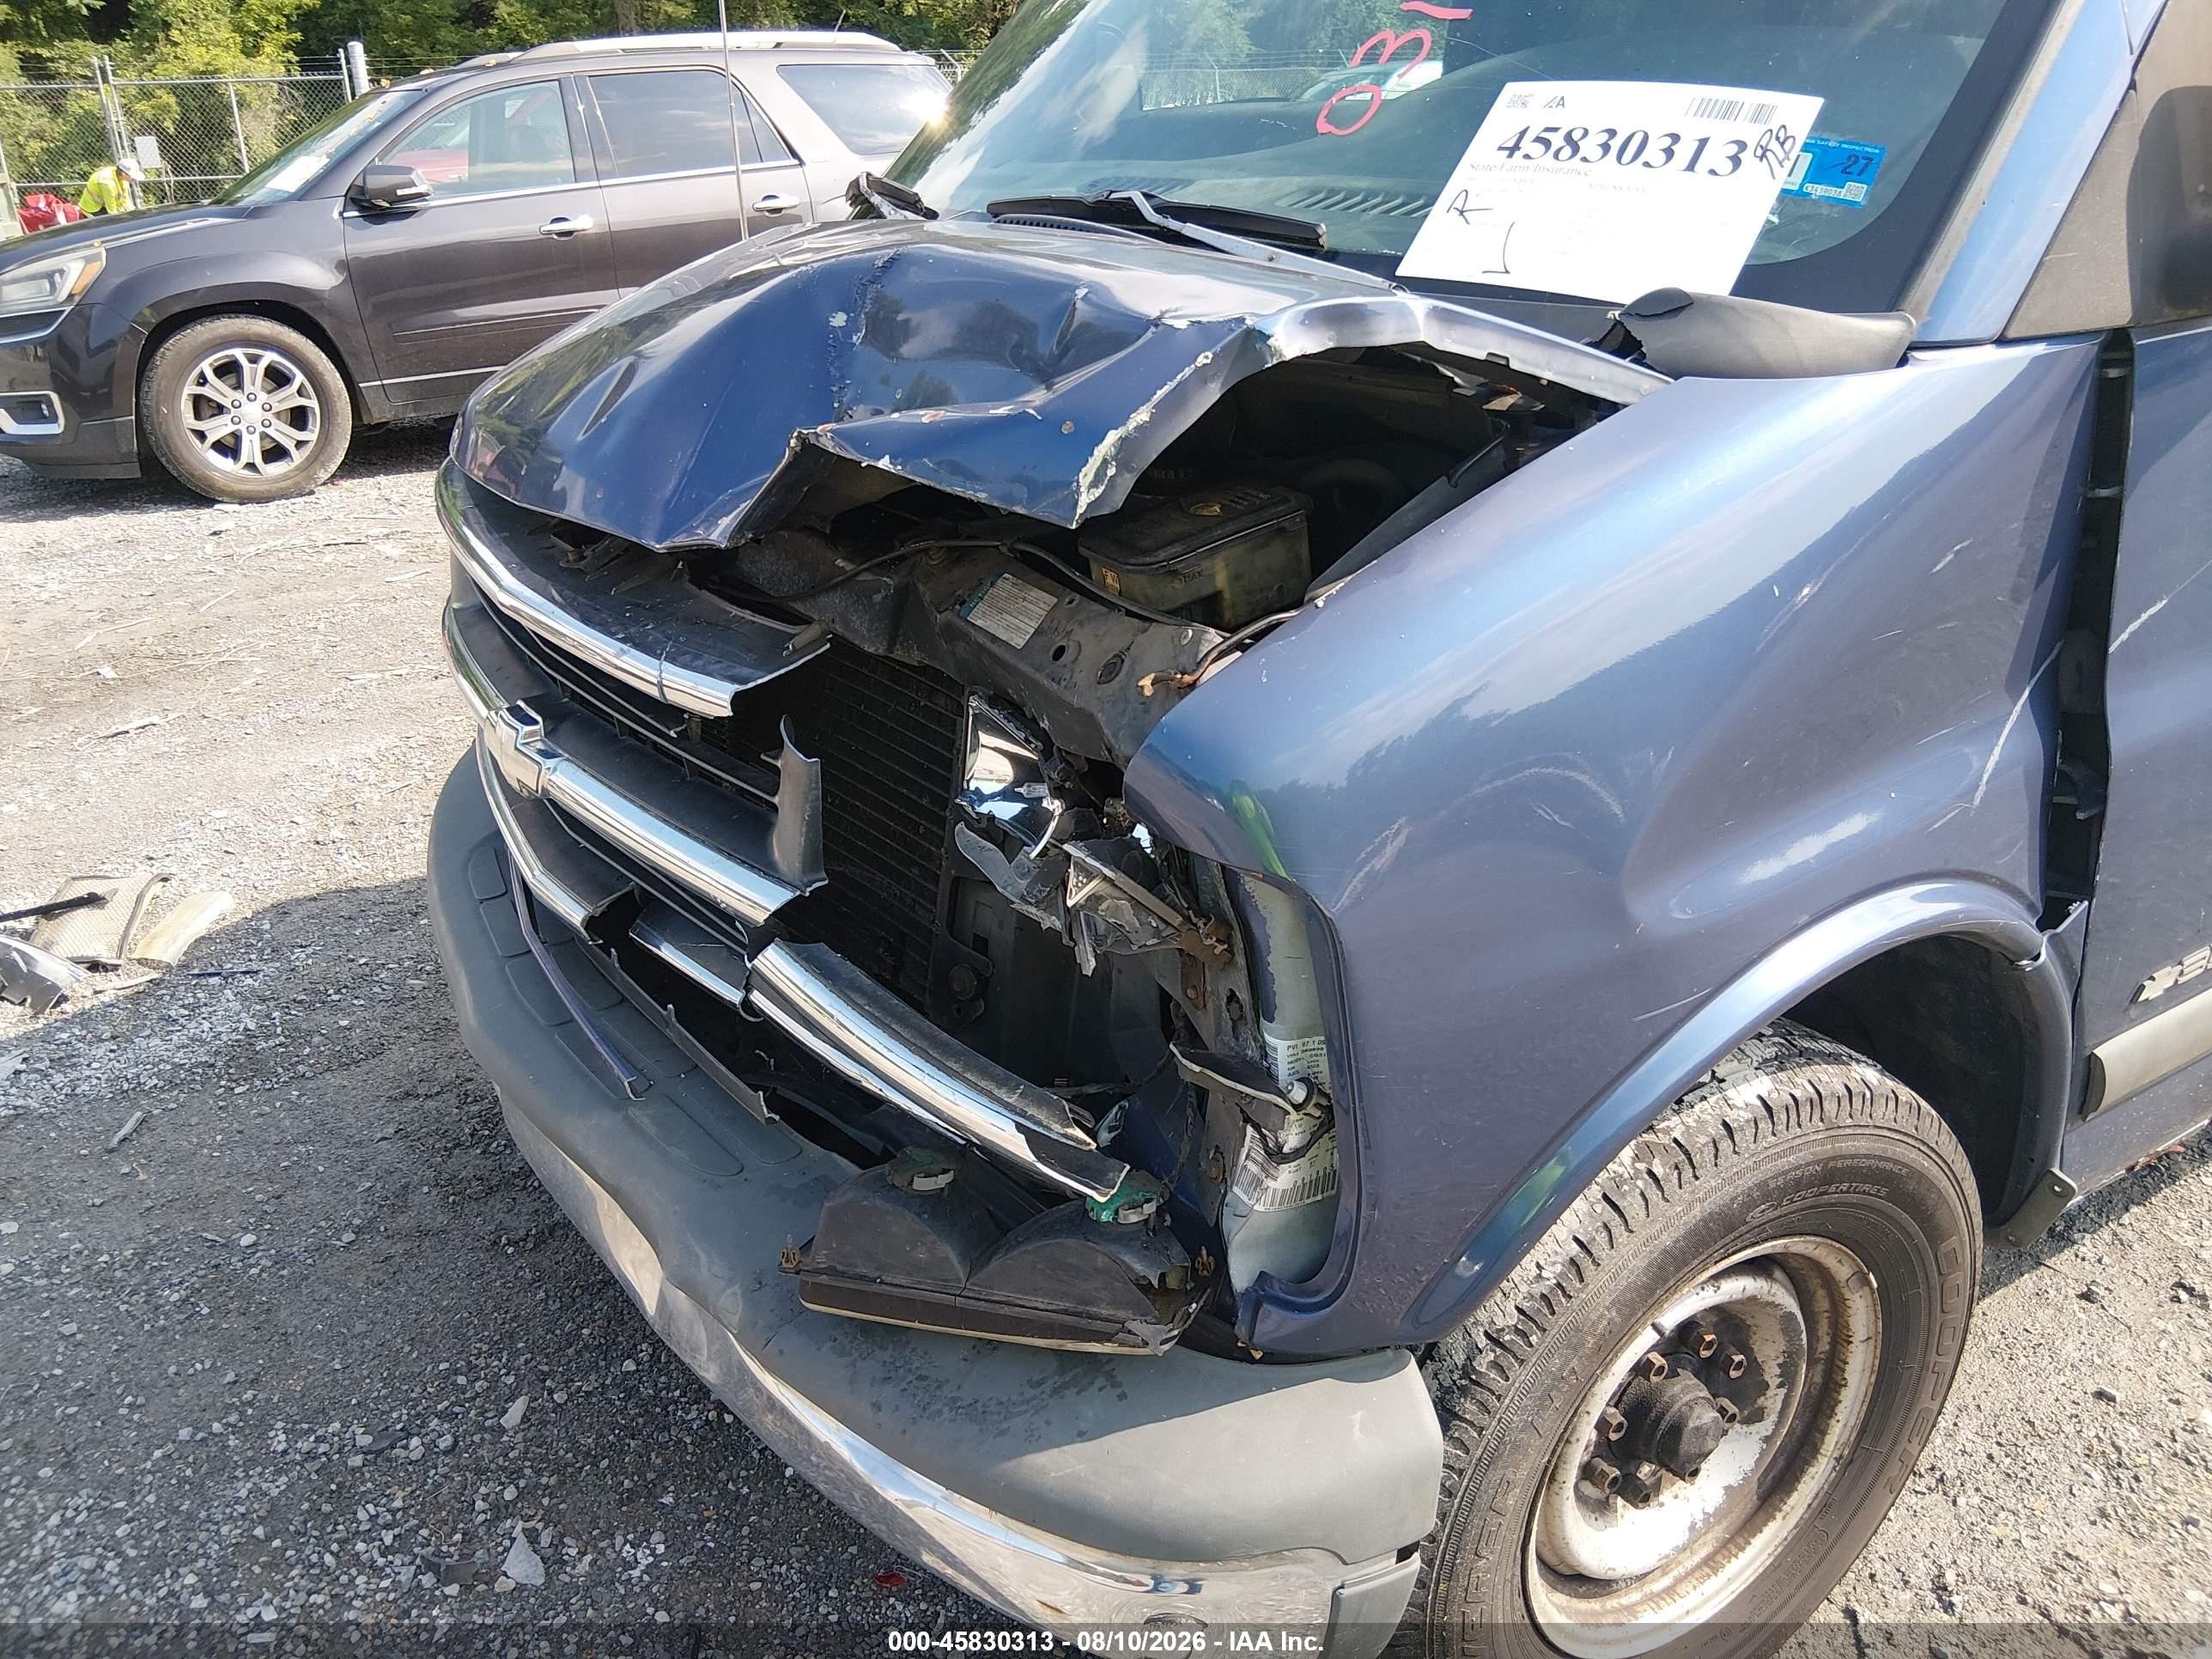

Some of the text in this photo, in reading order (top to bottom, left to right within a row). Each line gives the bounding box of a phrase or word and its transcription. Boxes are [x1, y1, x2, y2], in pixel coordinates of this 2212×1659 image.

[1496, 125, 1748, 177] 45830313
[1469, 161, 1592, 177] State Farm Insurance
[1840, 154, 1875, 178] 27
[1826, 1158, 1910, 1177] PERFORMANCE
[1883, 1236, 1960, 1495] COOPER
